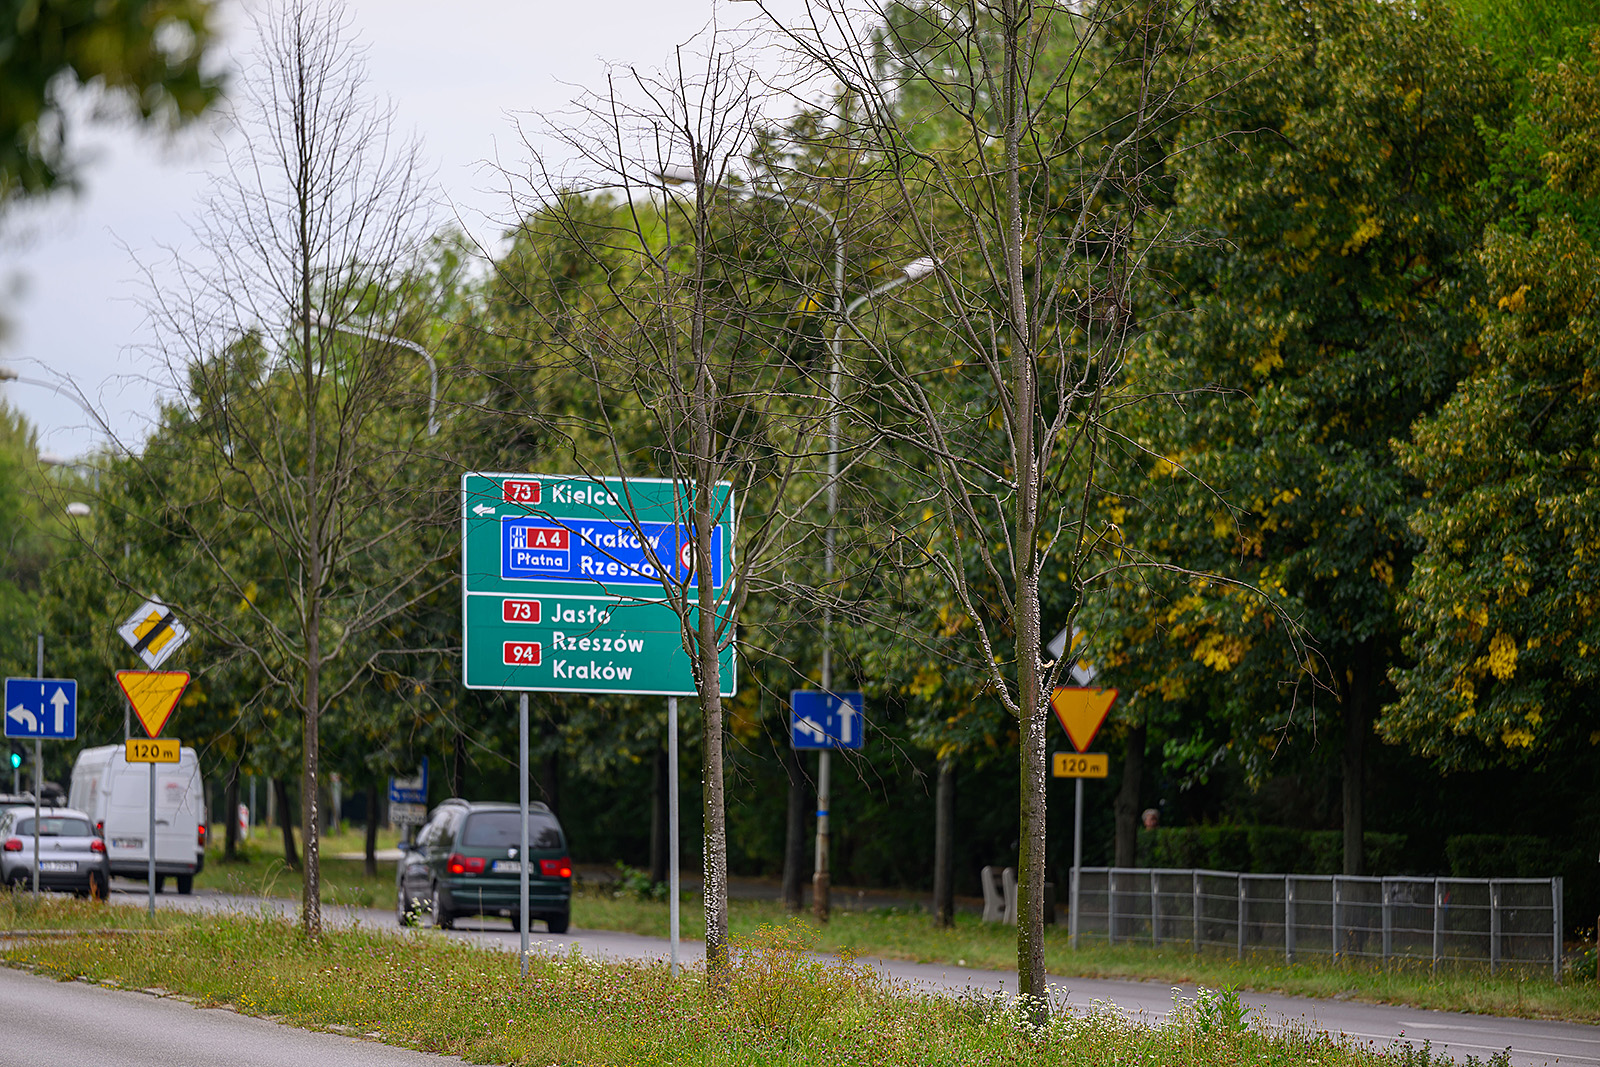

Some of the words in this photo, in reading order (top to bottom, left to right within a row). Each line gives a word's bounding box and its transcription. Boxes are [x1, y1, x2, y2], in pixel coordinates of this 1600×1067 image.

[512, 484, 532, 500] 73
[552, 484, 619, 506] Kielce
[581, 527, 660, 550] Kraków
[517, 552, 563, 567] Płatna
[511, 603, 531, 619] 73
[551, 603, 611, 625] Jasło
[553, 631, 645, 653] Rzeszów
[513, 645, 533, 662] 94
[553, 659, 633, 681] Kraków
[134, 744, 160, 759] 120
[163, 750, 174, 759] m
[1062, 759, 1087, 773] 120
[1090, 765, 1101, 773] m
